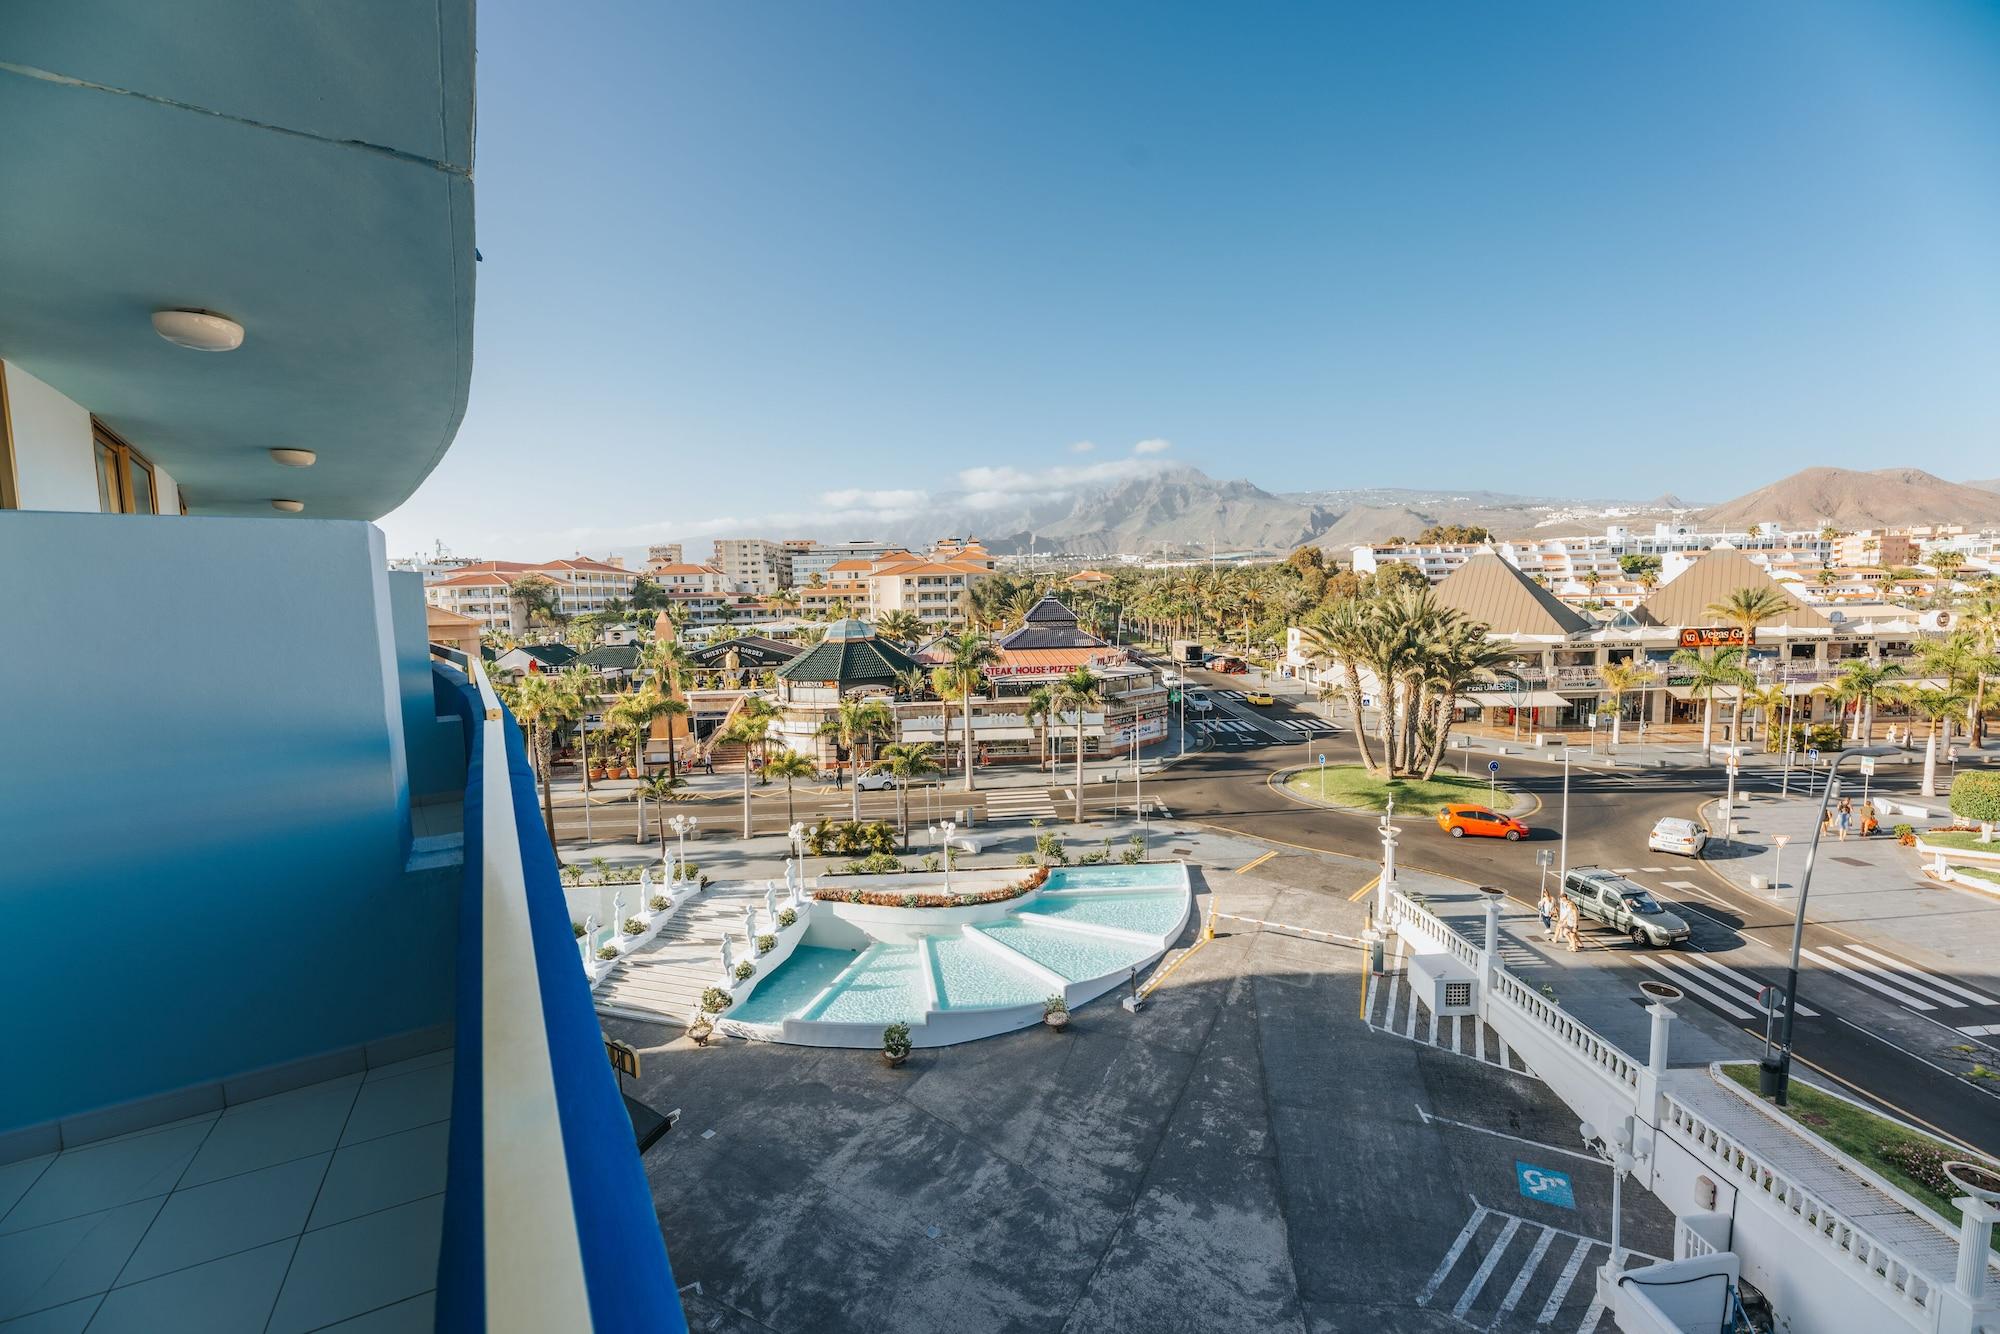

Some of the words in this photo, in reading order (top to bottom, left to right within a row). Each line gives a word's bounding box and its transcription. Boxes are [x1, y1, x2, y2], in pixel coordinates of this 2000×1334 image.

[1686, 634, 1696, 642] VG
[1701, 629, 1729, 641] Vegas
[702, 646, 730, 660] ORIENTAL
[740, 646, 765, 658] GARDEN
[985, 667, 1012, 675] STEAK
[1016, 665, 1046, 674] HOUSE
[990, 713, 1016, 725] RKS
